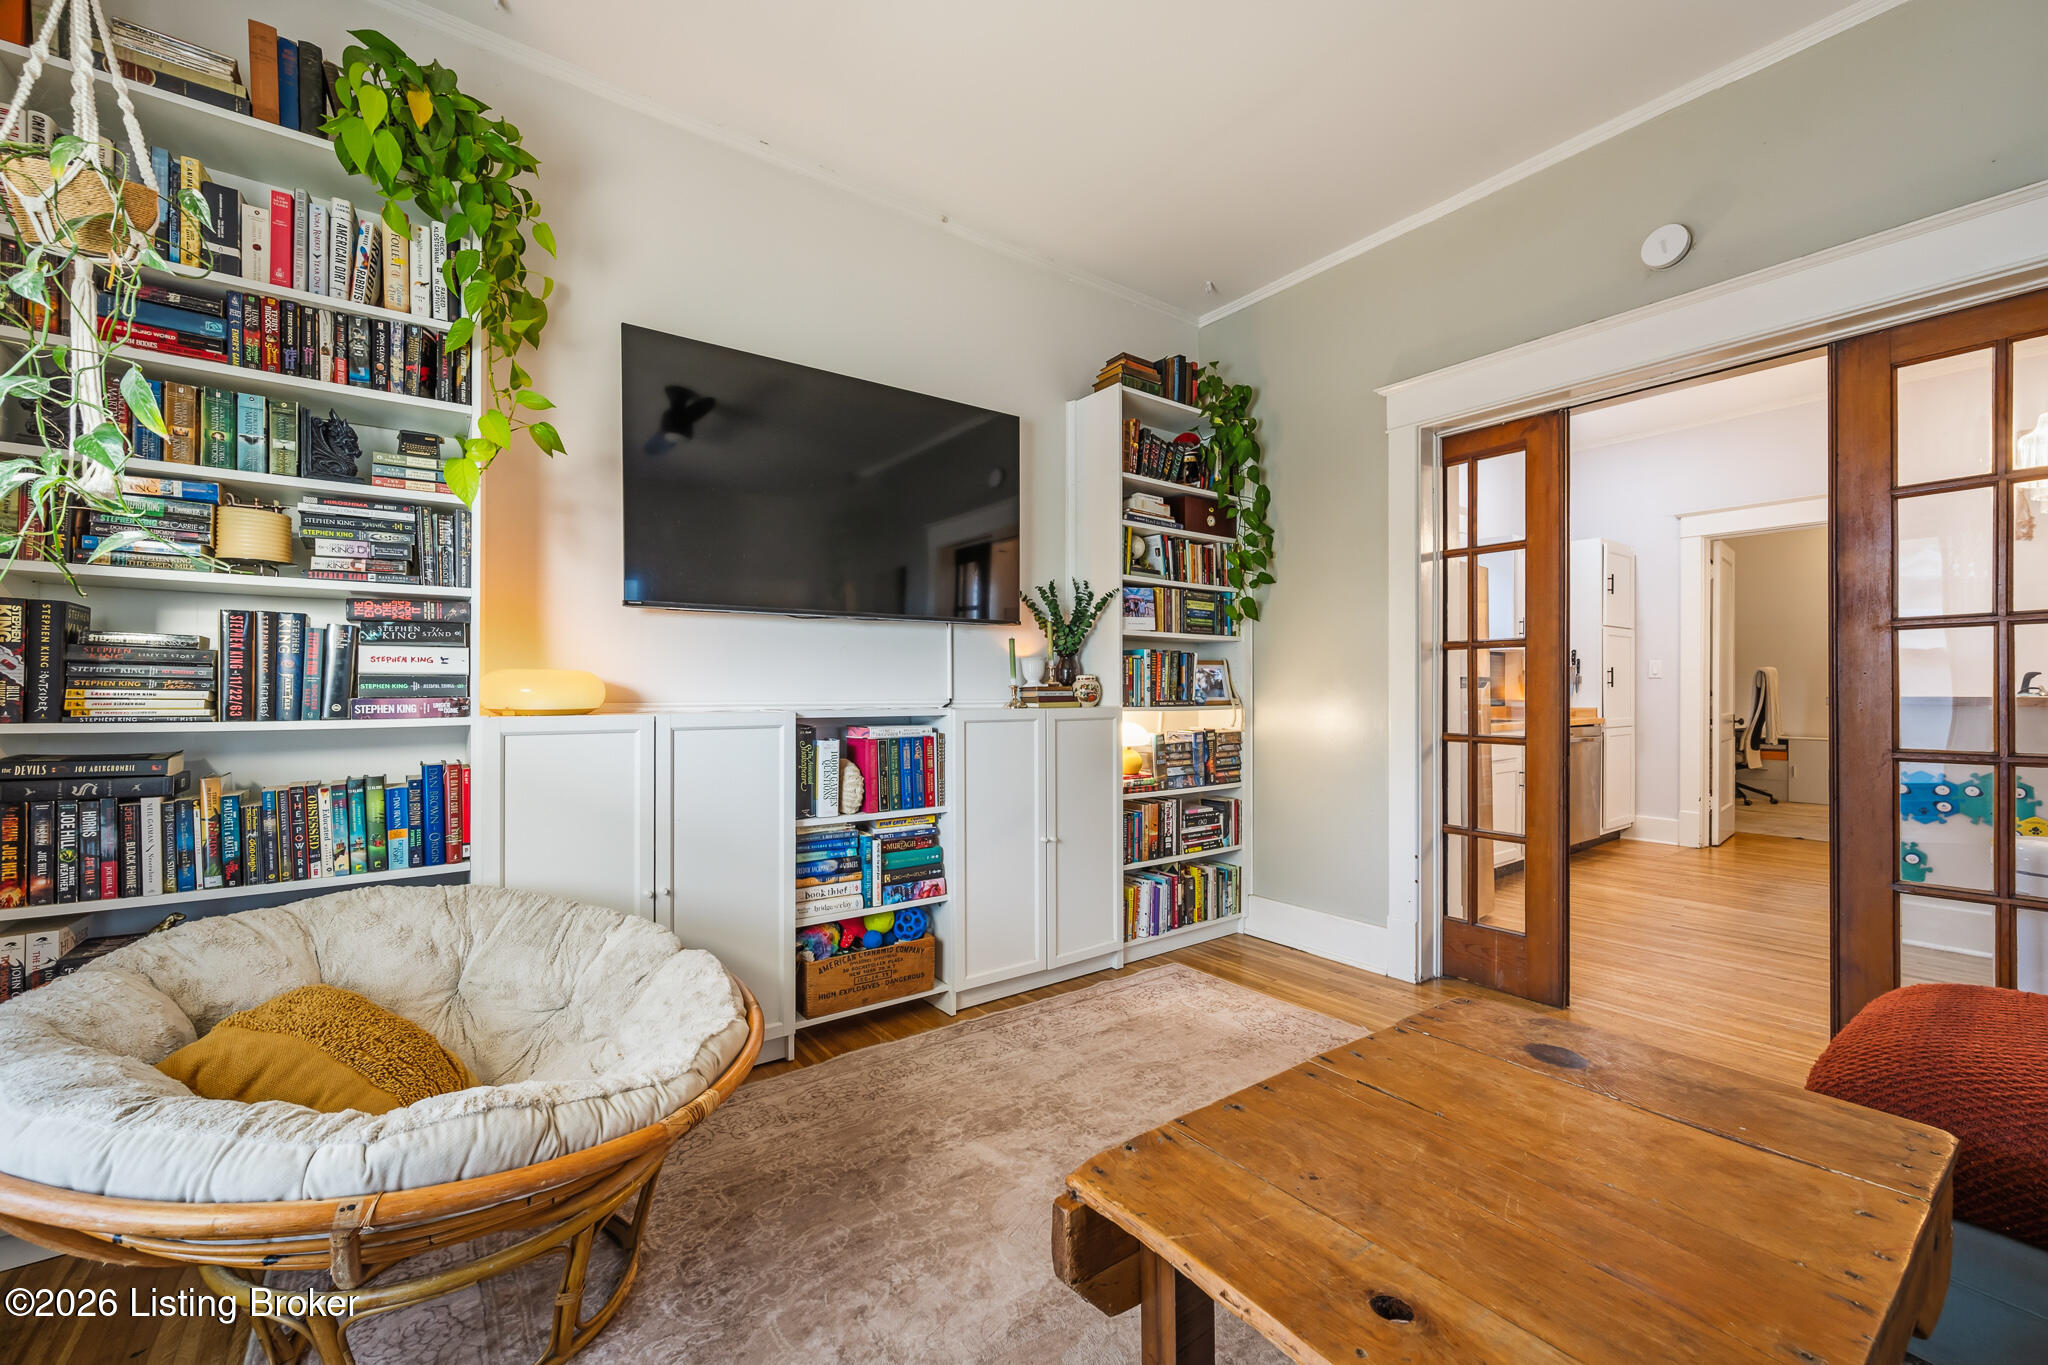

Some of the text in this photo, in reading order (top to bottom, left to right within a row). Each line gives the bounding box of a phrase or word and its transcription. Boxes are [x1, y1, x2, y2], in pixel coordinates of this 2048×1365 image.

[32, 115, 45, 132] CRY
[335, 222, 348, 285] AMERICAN DIRT
[354, 269, 366, 300] RABBITS
[264, 306, 272, 334] BROOKS
[232, 328, 240, 351] ENDER'S
[324, 500, 368, 508] HIROSHIMA
[100, 514, 134, 523] STEPHEN
[170, 522, 198, 530] CARRIE
[332, 546, 354, 554] KING
[354, 602, 364, 616] THE
[364, 600, 374, 618] END
[374, 602, 382, 614] OF
[382, 602, 392, 616] THE
[412, 606, 421, 614] IT
[0, 604, 12, 642] KING
[11, 604, 22, 642] STEPHEN
[40, 604, 51, 642] STEPHEN
[278, 620, 292, 654] KING
[292, 620, 300, 654] STEPHEN
[382, 632, 416, 640] KING
[40, 646, 50, 668] KING
[229, 616, 244, 716] STEPHEN KING 11/22/63
[370, 656, 434, 664] STEPHEN KING
[6, 686, 20, 701] BILLY
[354, 704, 416, 714] STEPHEN KING
[14, 764, 46, 776] DEVILS
[89, 764, 136, 772] ABERCROMBIE
[450, 769, 458, 778] THE
[798, 740, 812, 792] Shakespeare
[822, 760, 831, 800] QUESTIONS
[830, 776, 838, 807] GARDEN
[124, 808, 132, 821] JOE
[224, 800, 233, 830] PRATCHETT
[294, 794, 302, 818] THE
[410, 790, 421, 826] DAN BROWN
[428, 768, 440, 863] DAN BROWN ORIGIN
[60, 812, 75, 849] JOE HILL
[307, 795, 320, 850] OBSESSED
[322, 810, 330, 841] Educated
[393, 809, 401, 828] BROWN
[82, 810, 97, 884] HORNS JOE HILL
[208, 822, 217, 857] NATION
[225, 836, 234, 858] BAXTER
[295, 827, 304, 866] POWER
[2, 844, 18, 881] JOE HILL
[37, 851, 47, 876] JOE HILL
[126, 842, 136, 864] BLACK
[60, 863, 68, 891] WEATHER
[126, 866, 136, 888] PHONE
[166, 861, 174, 888] STARDUST
[805, 886, 848, 899] book thief
[814, 904, 832, 912] bridge
[32, 950, 40, 964] THE
[818, 946, 924, 975] AMERICAN CYANAMID COMPANY
[12, 966, 22, 988] JOHN
[818, 991, 836, 1000] HIGH
[838, 982, 880, 996] EXPLOSIVES
[885, 972, 925, 986] DANGEROUS
